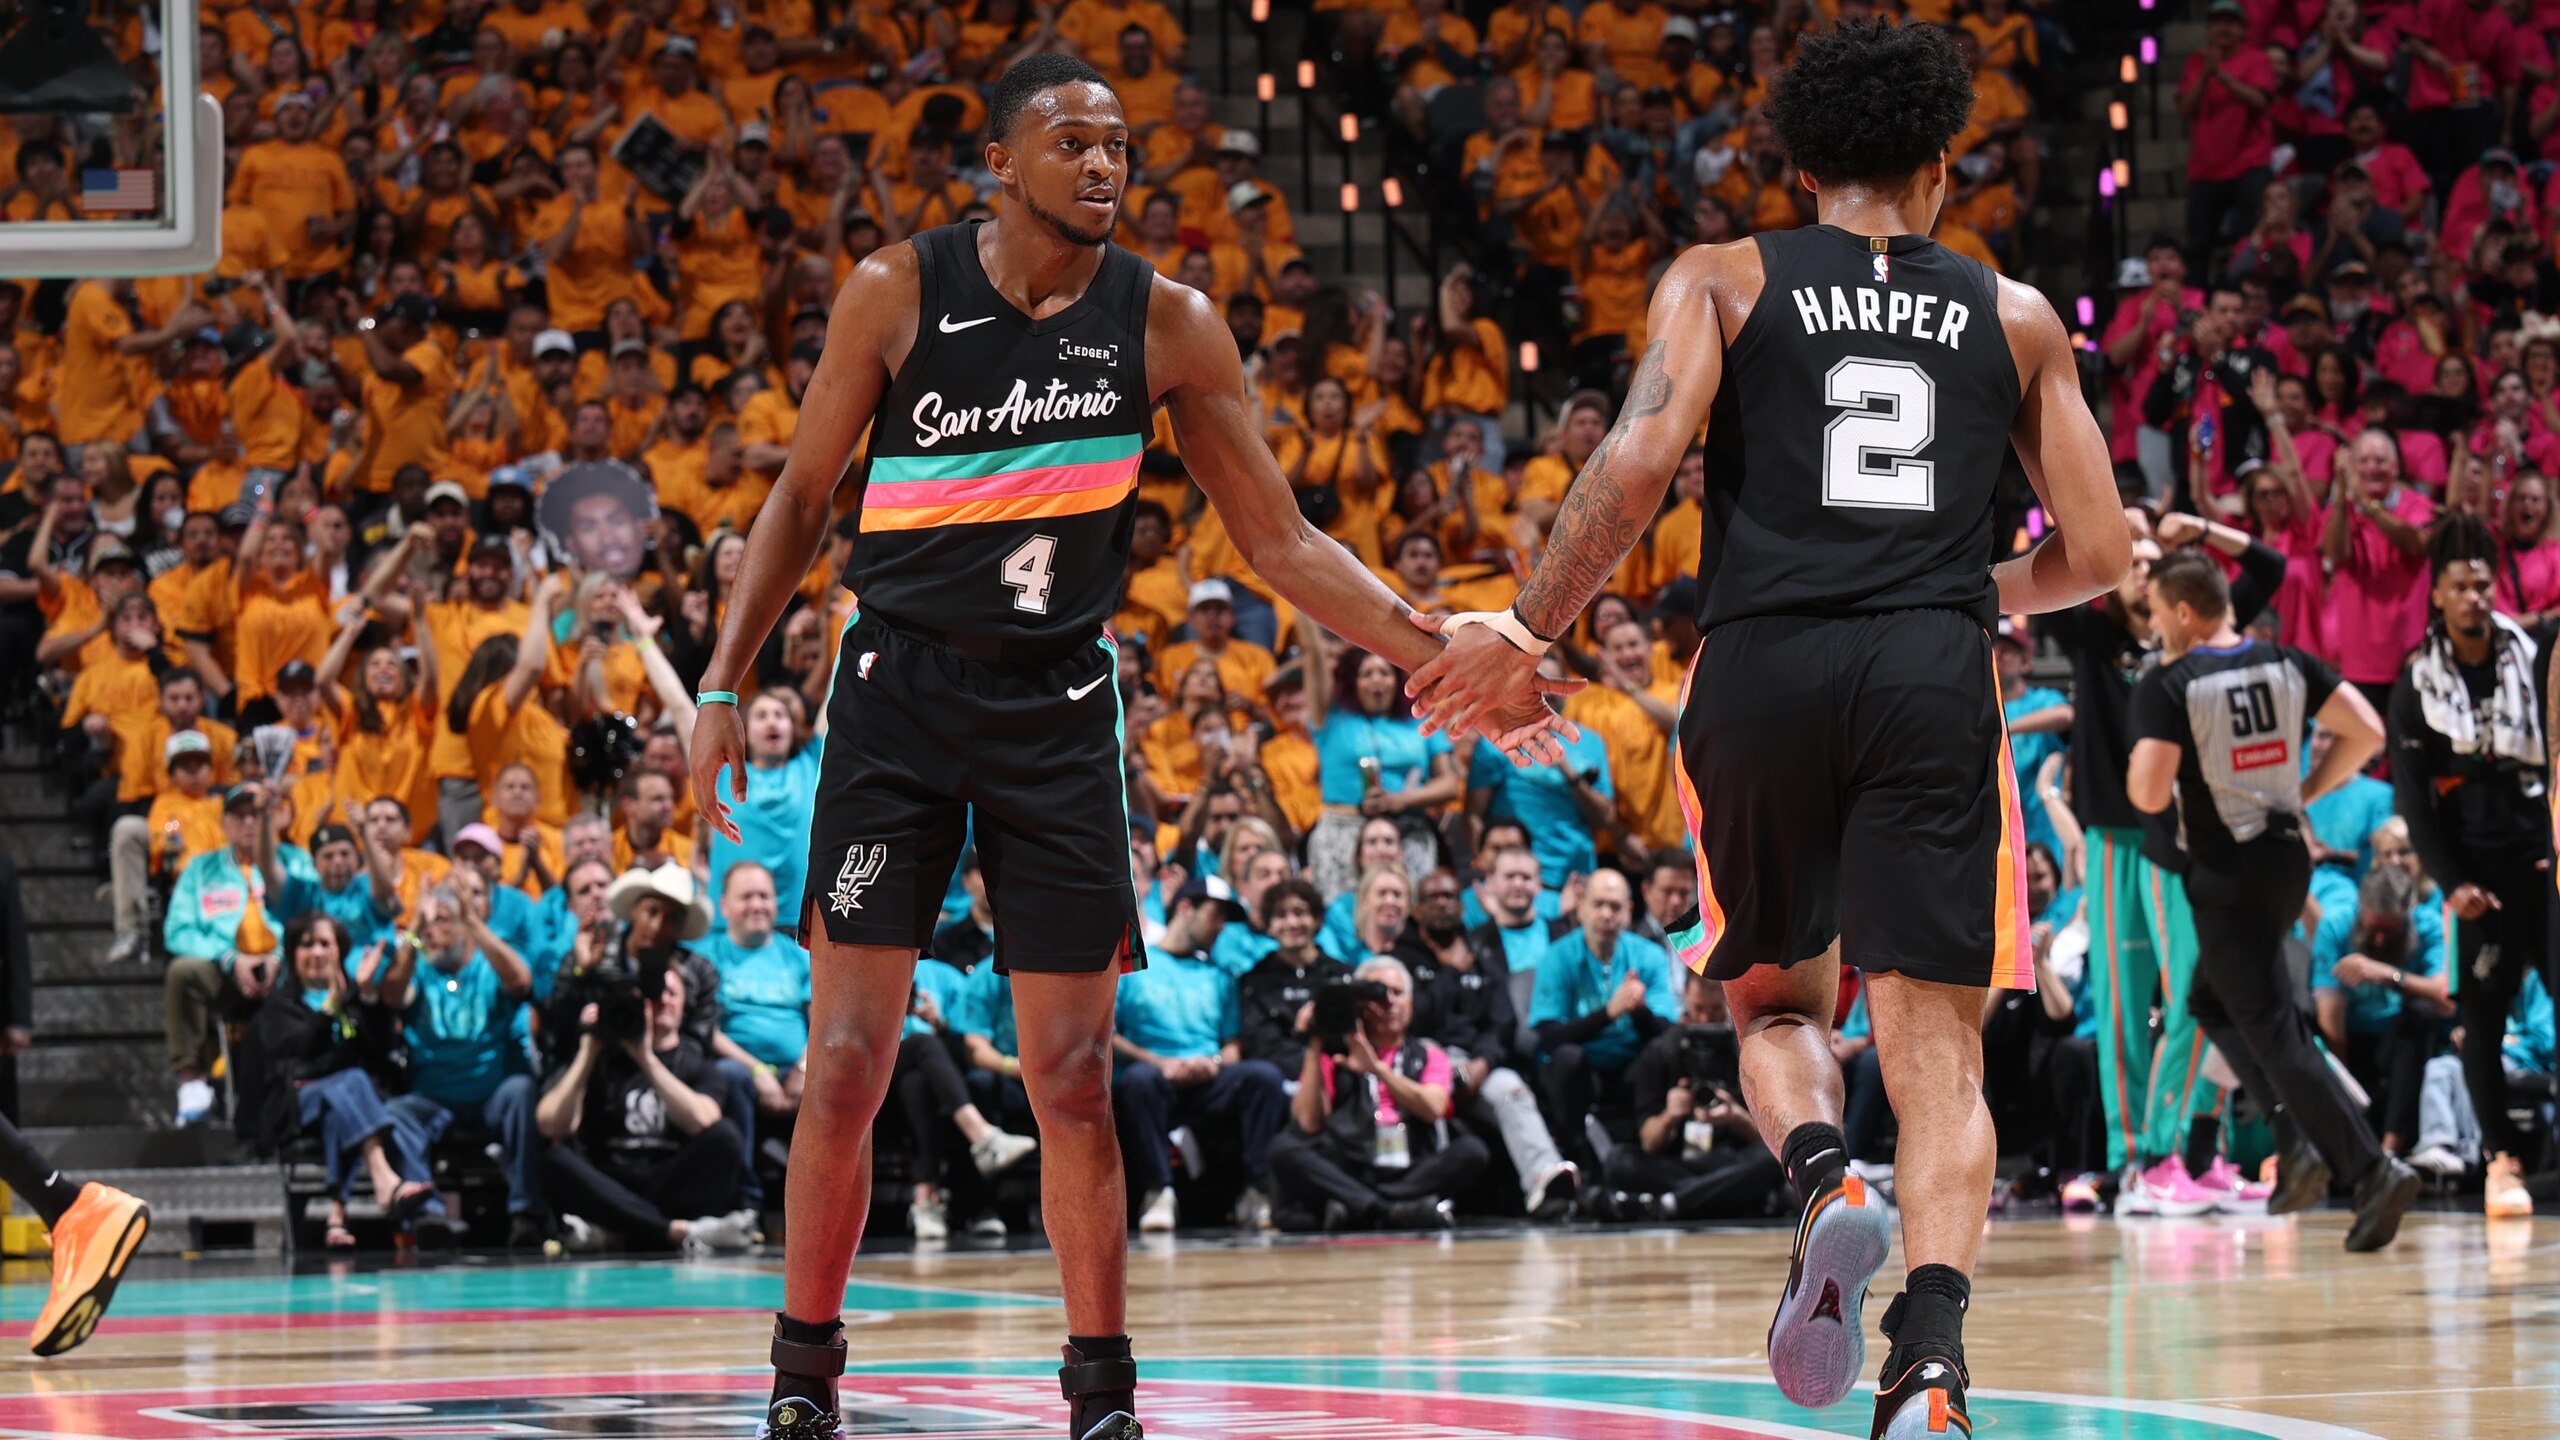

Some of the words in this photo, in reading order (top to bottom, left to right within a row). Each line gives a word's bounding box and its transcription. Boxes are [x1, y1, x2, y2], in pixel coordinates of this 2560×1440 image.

[1792, 286, 1969, 350] HARPER
[1066, 344, 1110, 360] LEDGER
[912, 391, 981, 447] San
[986, 377, 1121, 435] Antonio
[1822, 355, 1936, 511] 2
[1001, 533, 1058, 615] 4
[2226, 683, 2276, 737] 50
